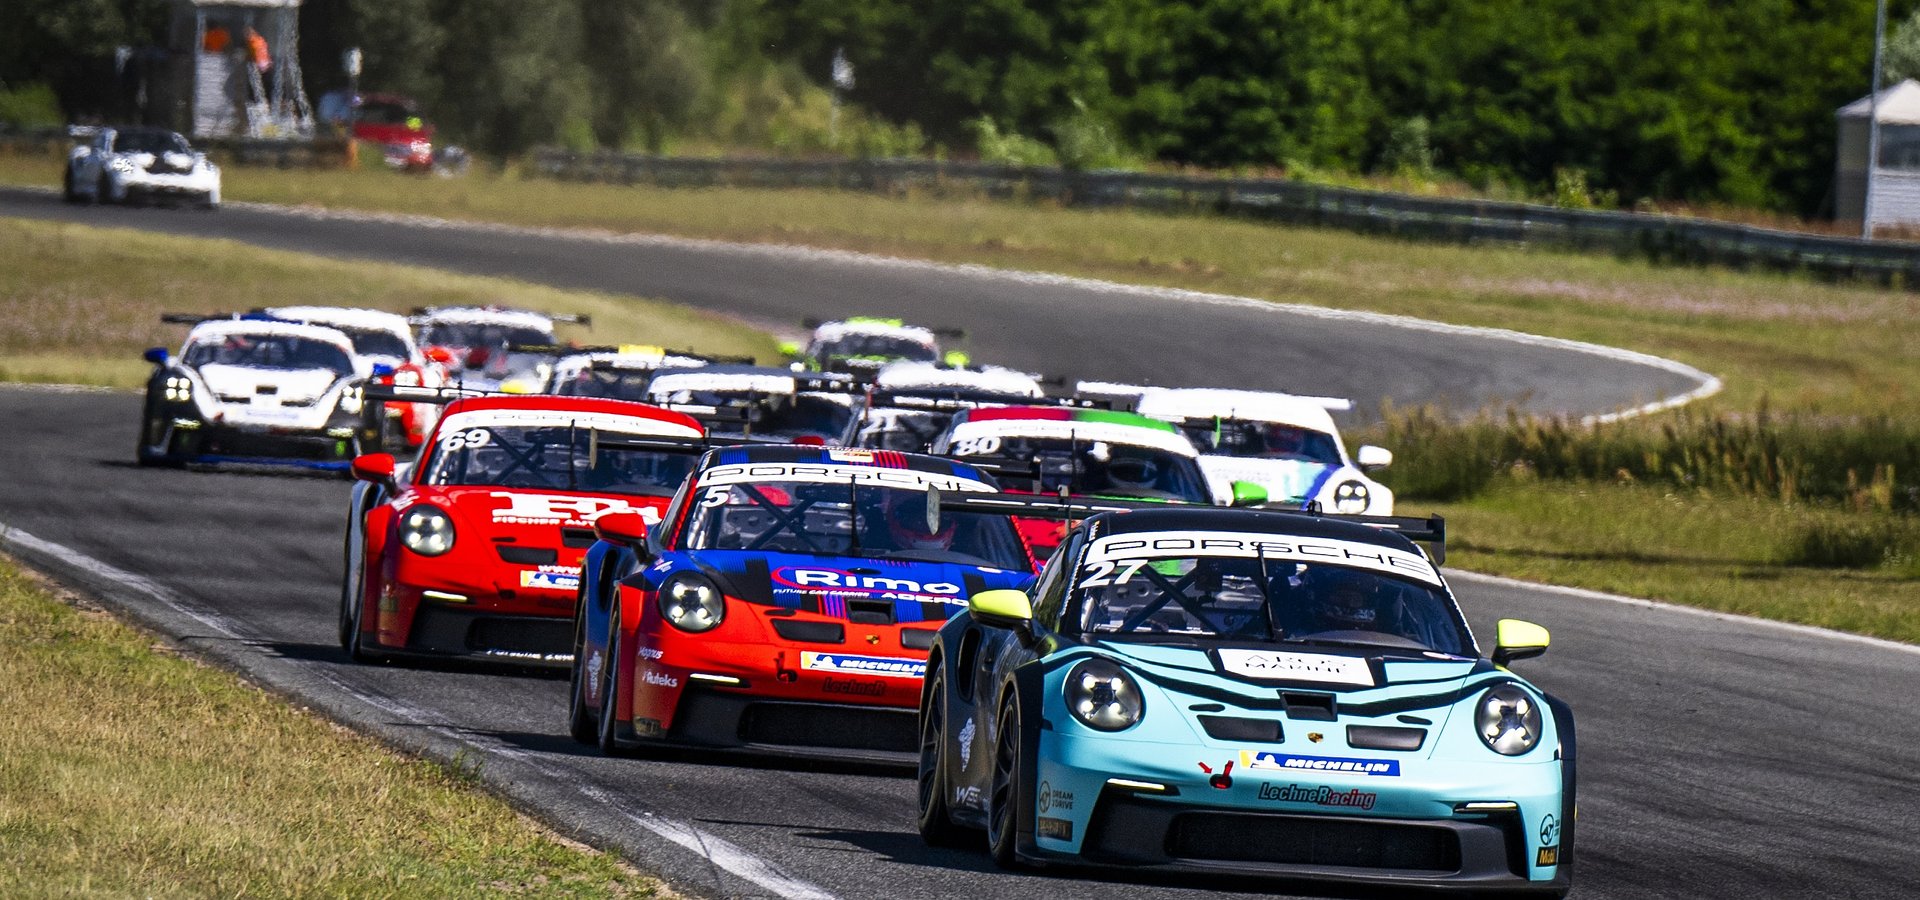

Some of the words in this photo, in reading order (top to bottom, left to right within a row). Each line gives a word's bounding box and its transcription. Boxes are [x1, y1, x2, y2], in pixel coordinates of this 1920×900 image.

[440, 428, 491, 451] 69
[956, 436, 1001, 456] 80
[706, 466, 985, 491] PORSCHE
[700, 484, 733, 508] 5
[492, 515, 561, 525] FISCHER
[1102, 538, 1431, 577] PORSCHE
[794, 569, 961, 594] Rimo
[1079, 559, 1149, 589] 27
[1284, 758, 1391, 773] MICHELIN
[1259, 782, 1377, 810] LechneRacing
